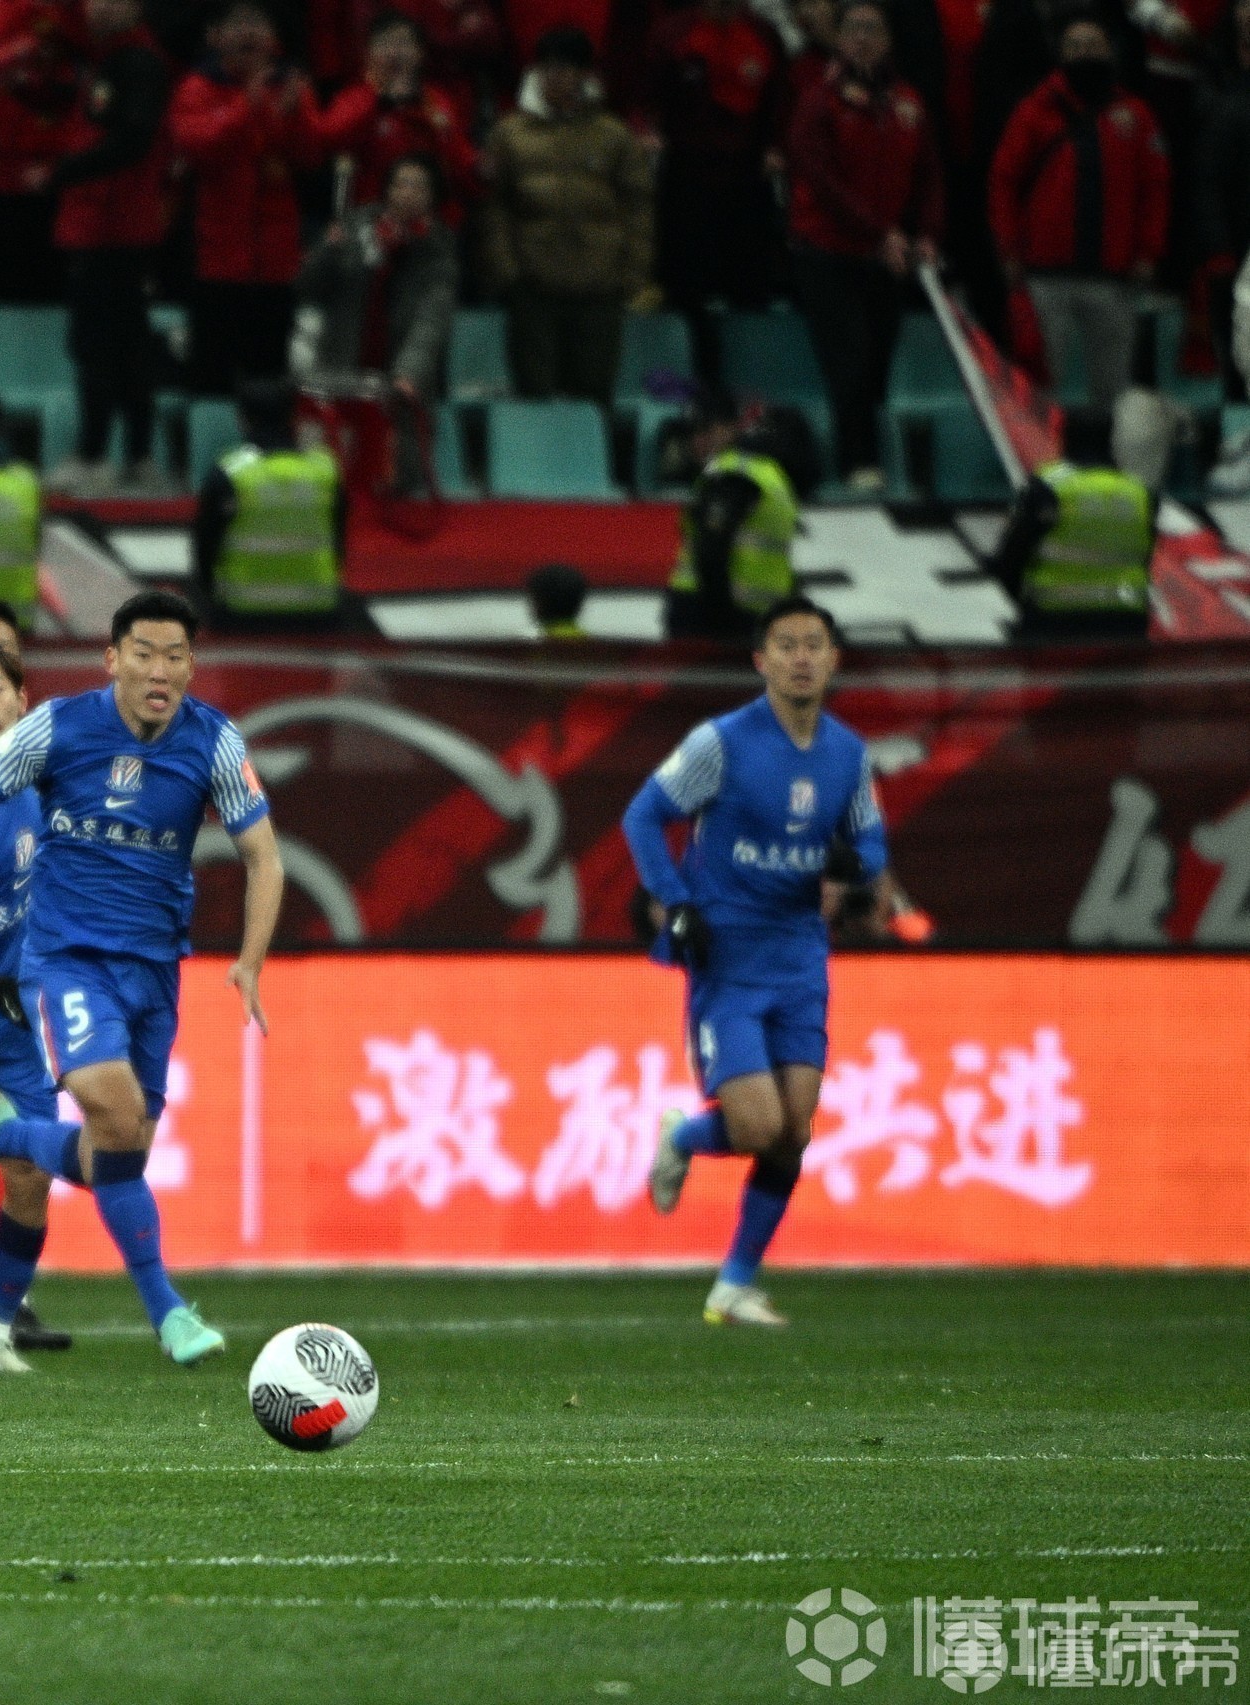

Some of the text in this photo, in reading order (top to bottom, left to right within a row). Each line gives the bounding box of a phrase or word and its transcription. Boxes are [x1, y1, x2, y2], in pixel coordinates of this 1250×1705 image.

[63, 991, 89, 1036] 5
[348, 1026, 1095, 1212] 激励共进
